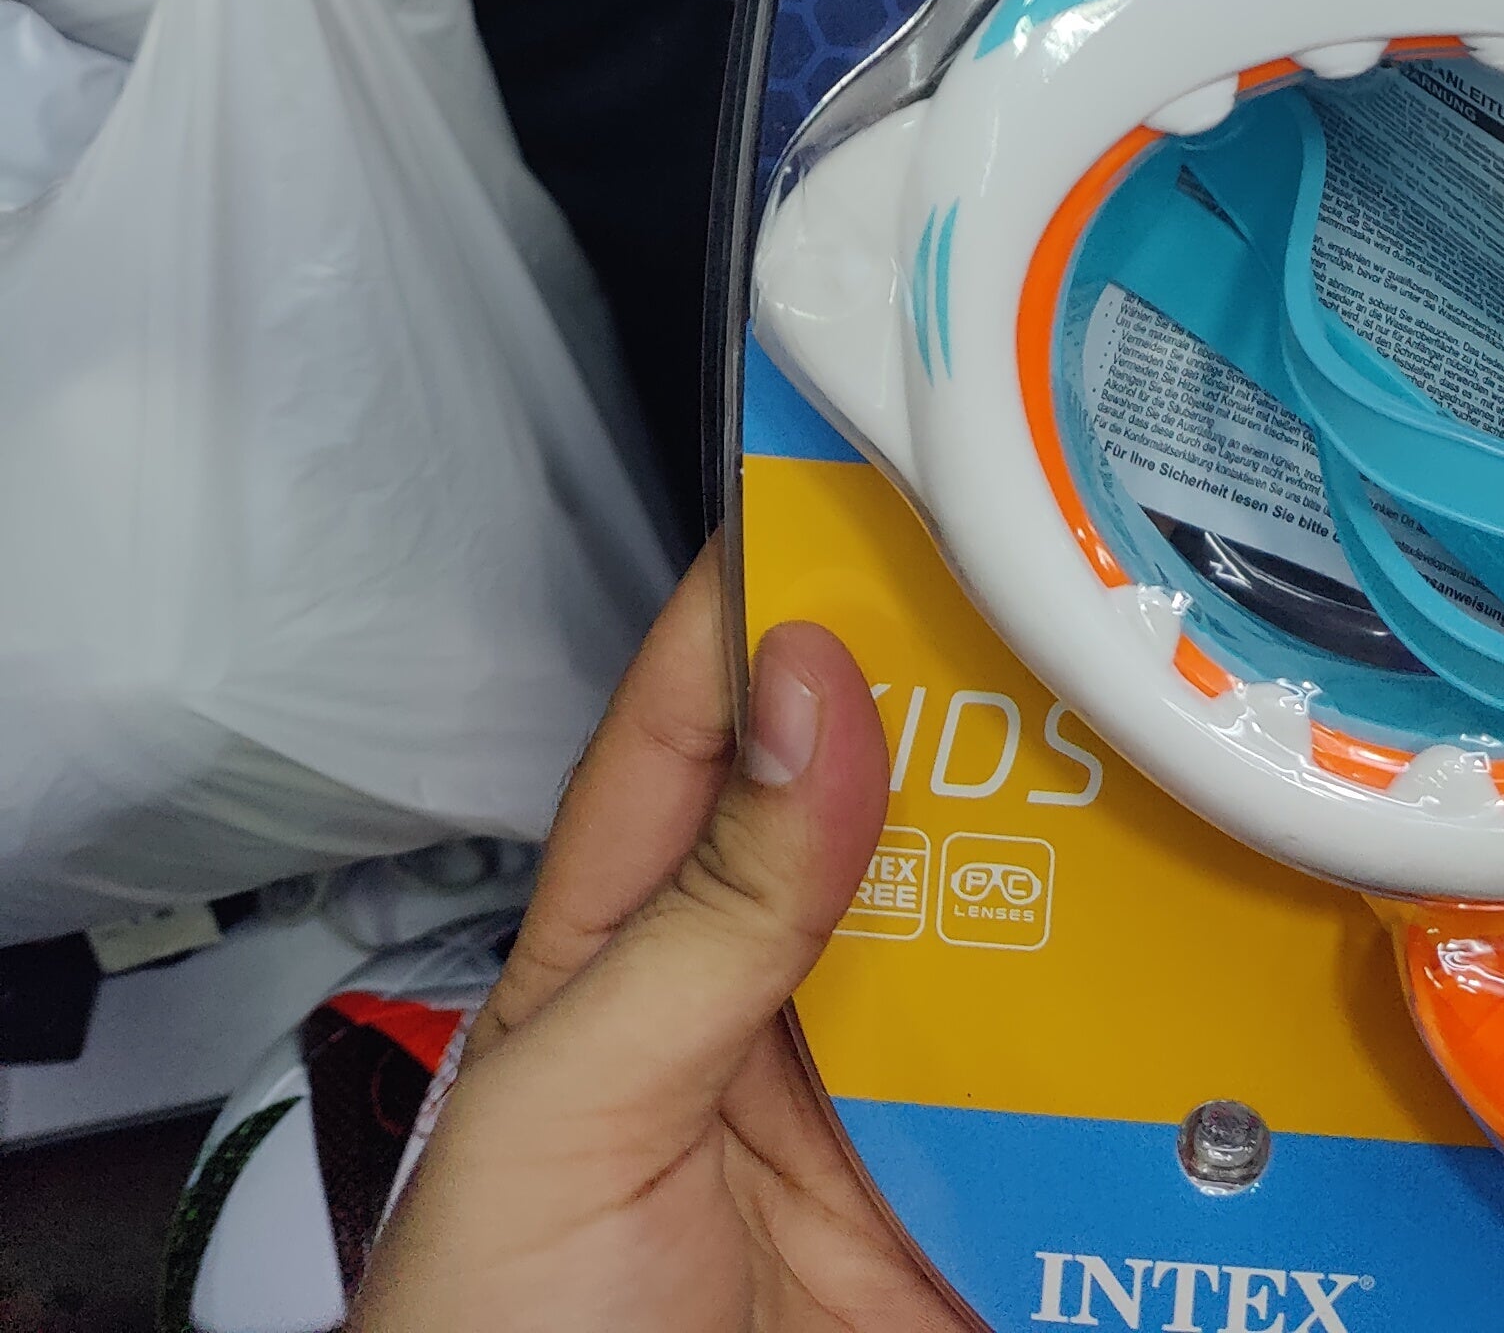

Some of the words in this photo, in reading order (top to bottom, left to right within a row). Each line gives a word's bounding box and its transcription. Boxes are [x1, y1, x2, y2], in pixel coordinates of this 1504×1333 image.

[1382, 277, 1399, 292] Sie
[1397, 308, 1415, 323] Sie
[1373, 334, 1393, 350] den
[1438, 376, 1461, 393] dass
[1460, 388, 1473, 399] es
[1102, 439, 1128, 460] Für
[1128, 449, 1158, 472] Ihre
[1156, 460, 1231, 500] Sicherheit
[1229, 488, 1270, 514] lesen
[1270, 503, 1297, 524] Sie
[1296, 514, 1331, 538] bitte
[870, 683, 1103, 807] IDS
[867, 855, 918, 885] TEX
[854, 884, 918, 910] REE
[952, 903, 1035, 925] LENSES
[1030, 1251, 1362, 1333] INTEX
